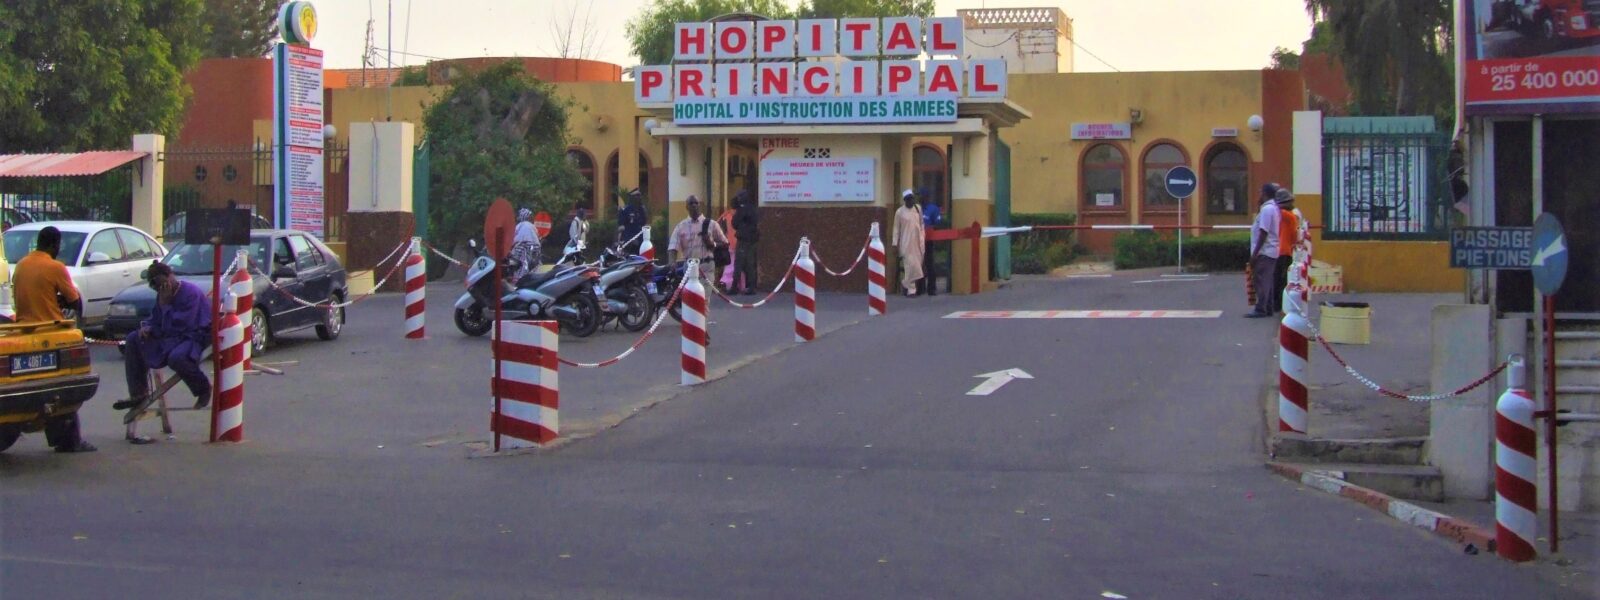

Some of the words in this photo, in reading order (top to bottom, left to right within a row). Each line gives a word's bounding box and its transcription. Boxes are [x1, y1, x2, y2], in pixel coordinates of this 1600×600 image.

[679, 22, 957, 55] HOPITAL
[1481, 65, 1488, 75] à
[1491, 64, 1521, 75] partir
[1524, 62, 1539, 72] de
[640, 64, 999, 98] PRINCIPAL
[1491, 74, 1516, 92] 25
[1521, 71, 1557, 89] 400
[1562, 69, 1598, 87] 000
[675, 103, 734, 119] HOPITAL
[740, 101, 853, 118] D'INSTRUCTION
[860, 101, 887, 117] DES
[893, 100, 955, 117] ARMEES
[762, 138, 800, 149] ENTREE
[1453, 230, 1533, 249] PASSAGE
[1455, 248, 1531, 267] PIETONS
